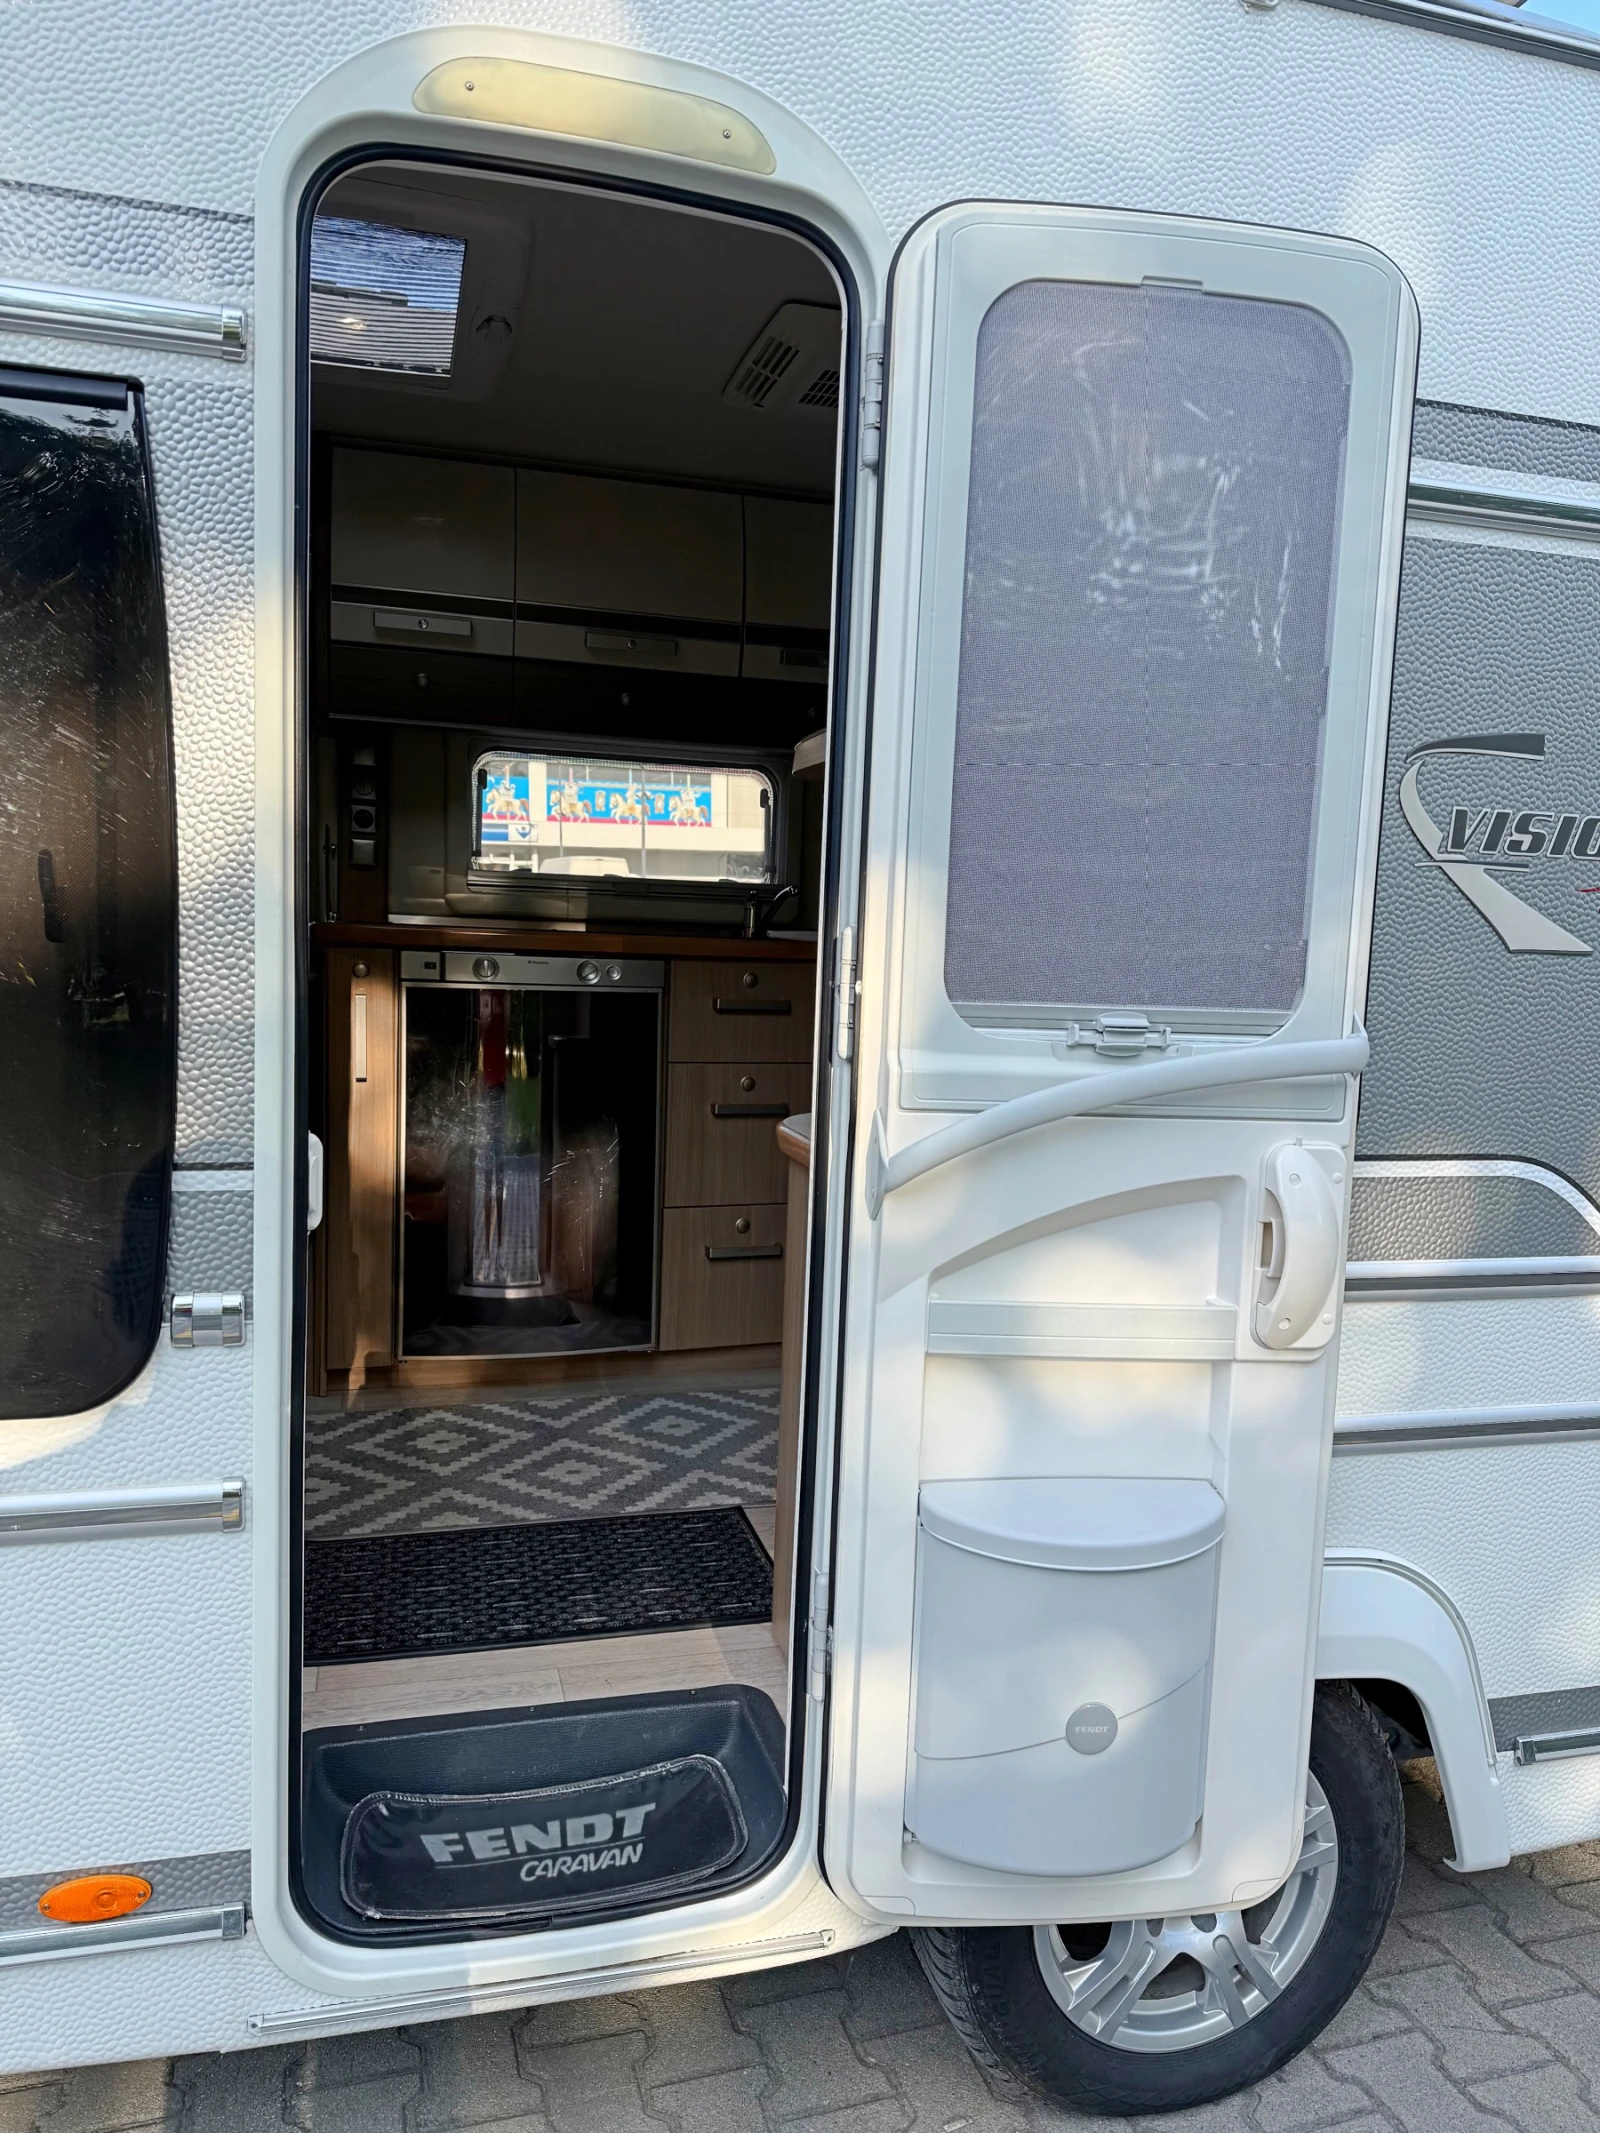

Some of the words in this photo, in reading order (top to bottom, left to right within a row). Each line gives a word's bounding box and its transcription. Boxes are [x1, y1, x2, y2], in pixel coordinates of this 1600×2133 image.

[1074, 1725, 1110, 1733] FENDT
[420, 1803, 656, 1863] FENDT
[520, 1843, 644, 1882] CARAVAN
